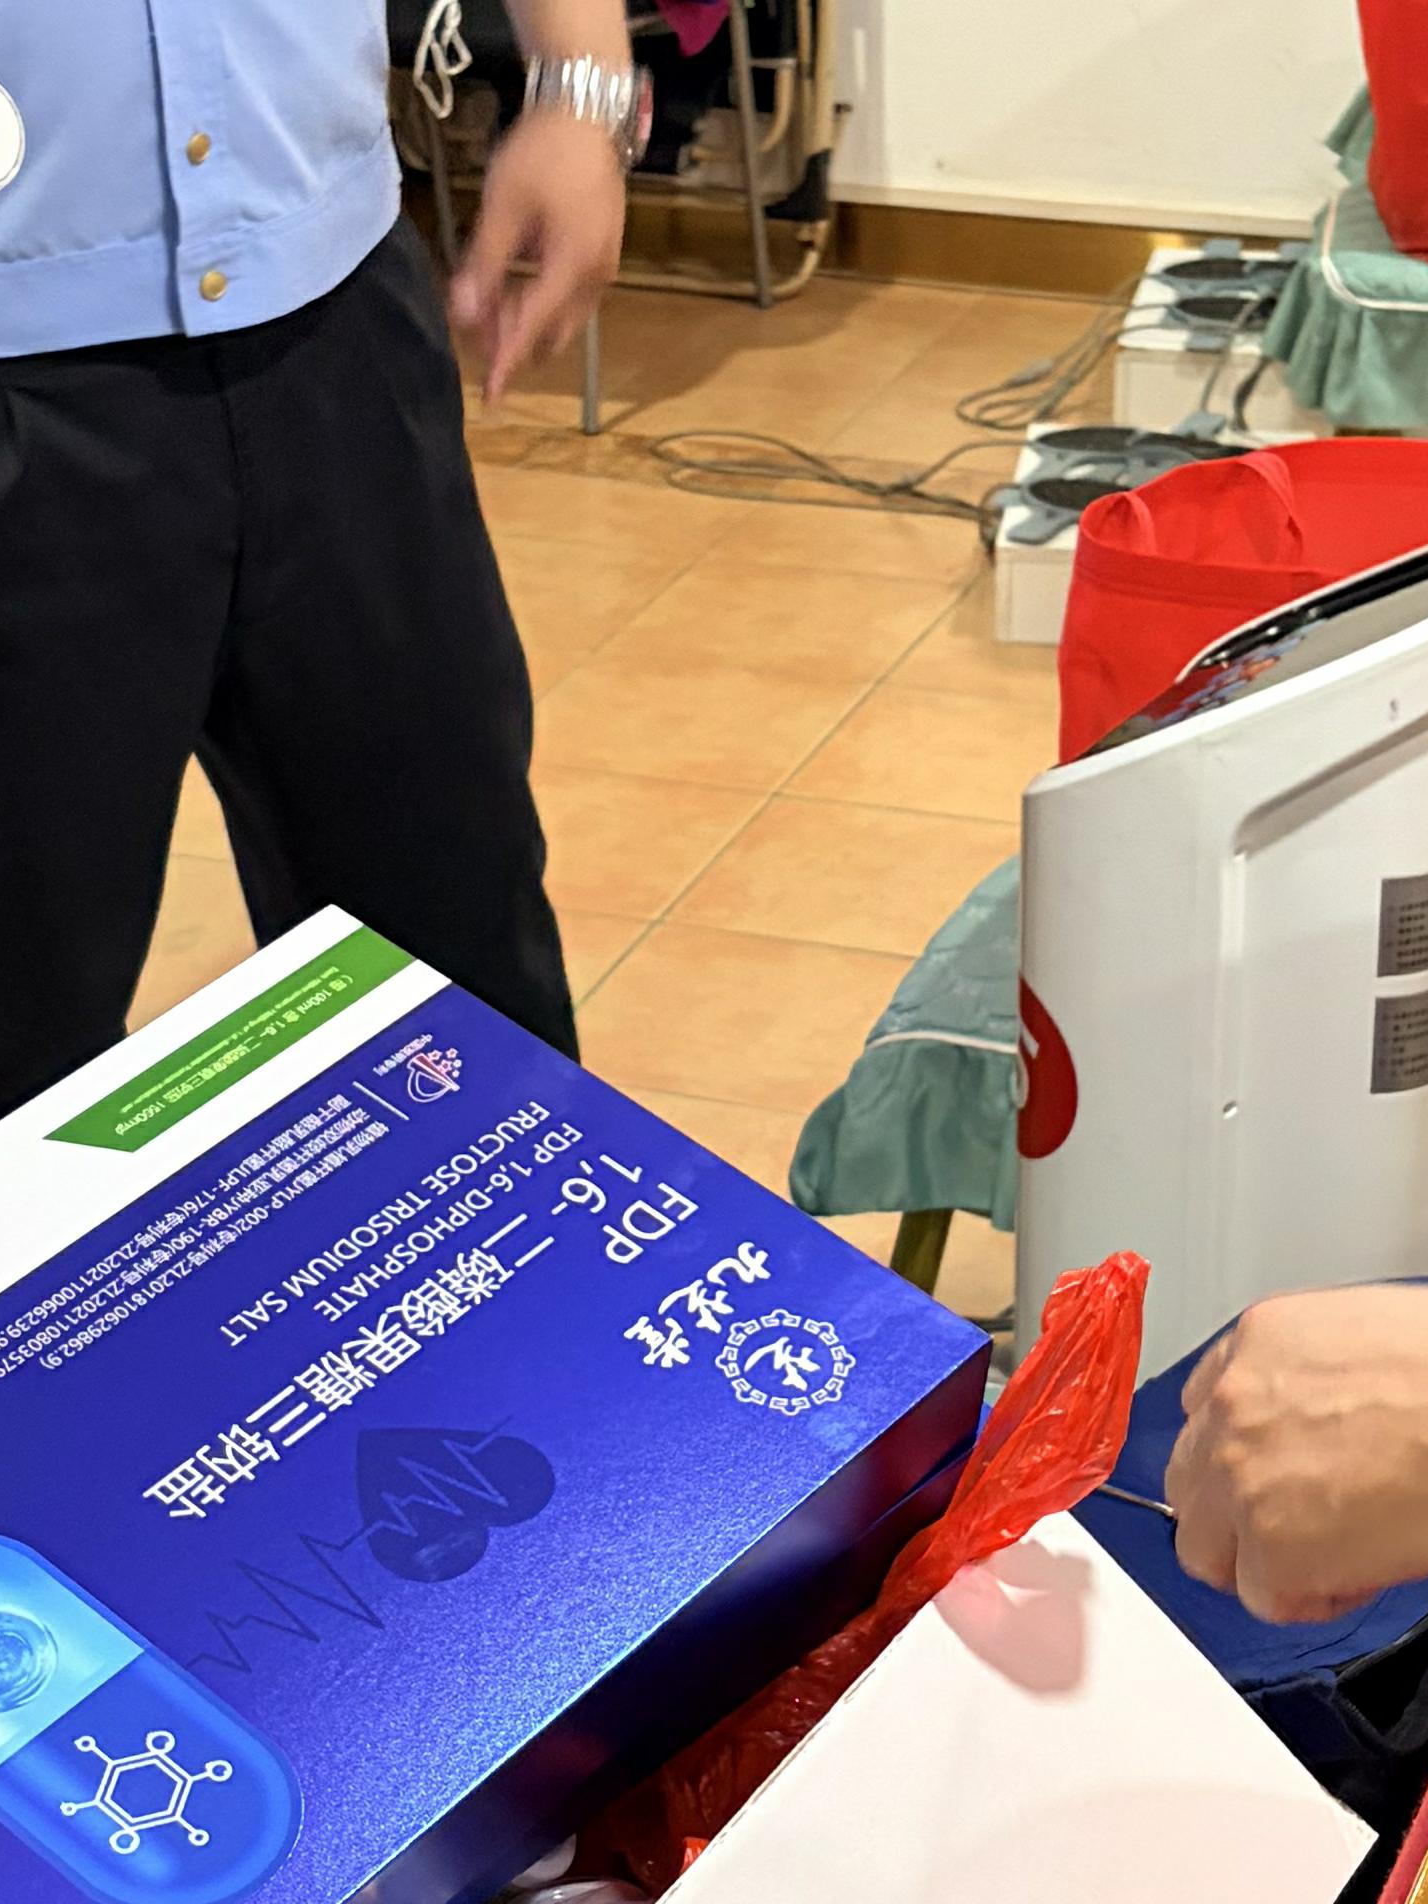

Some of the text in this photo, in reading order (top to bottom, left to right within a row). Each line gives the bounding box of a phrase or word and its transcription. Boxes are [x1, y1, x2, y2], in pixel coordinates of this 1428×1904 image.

[220, 1101, 549, 1345] FRUCTOSE TRISODIUM SALT
[313, 1122, 582, 1321] FDP 1,6-DIPHOSPHATE
[602, 1182, 698, 1263] FDP
[623, 1242, 770, 1367] 九芝堂
